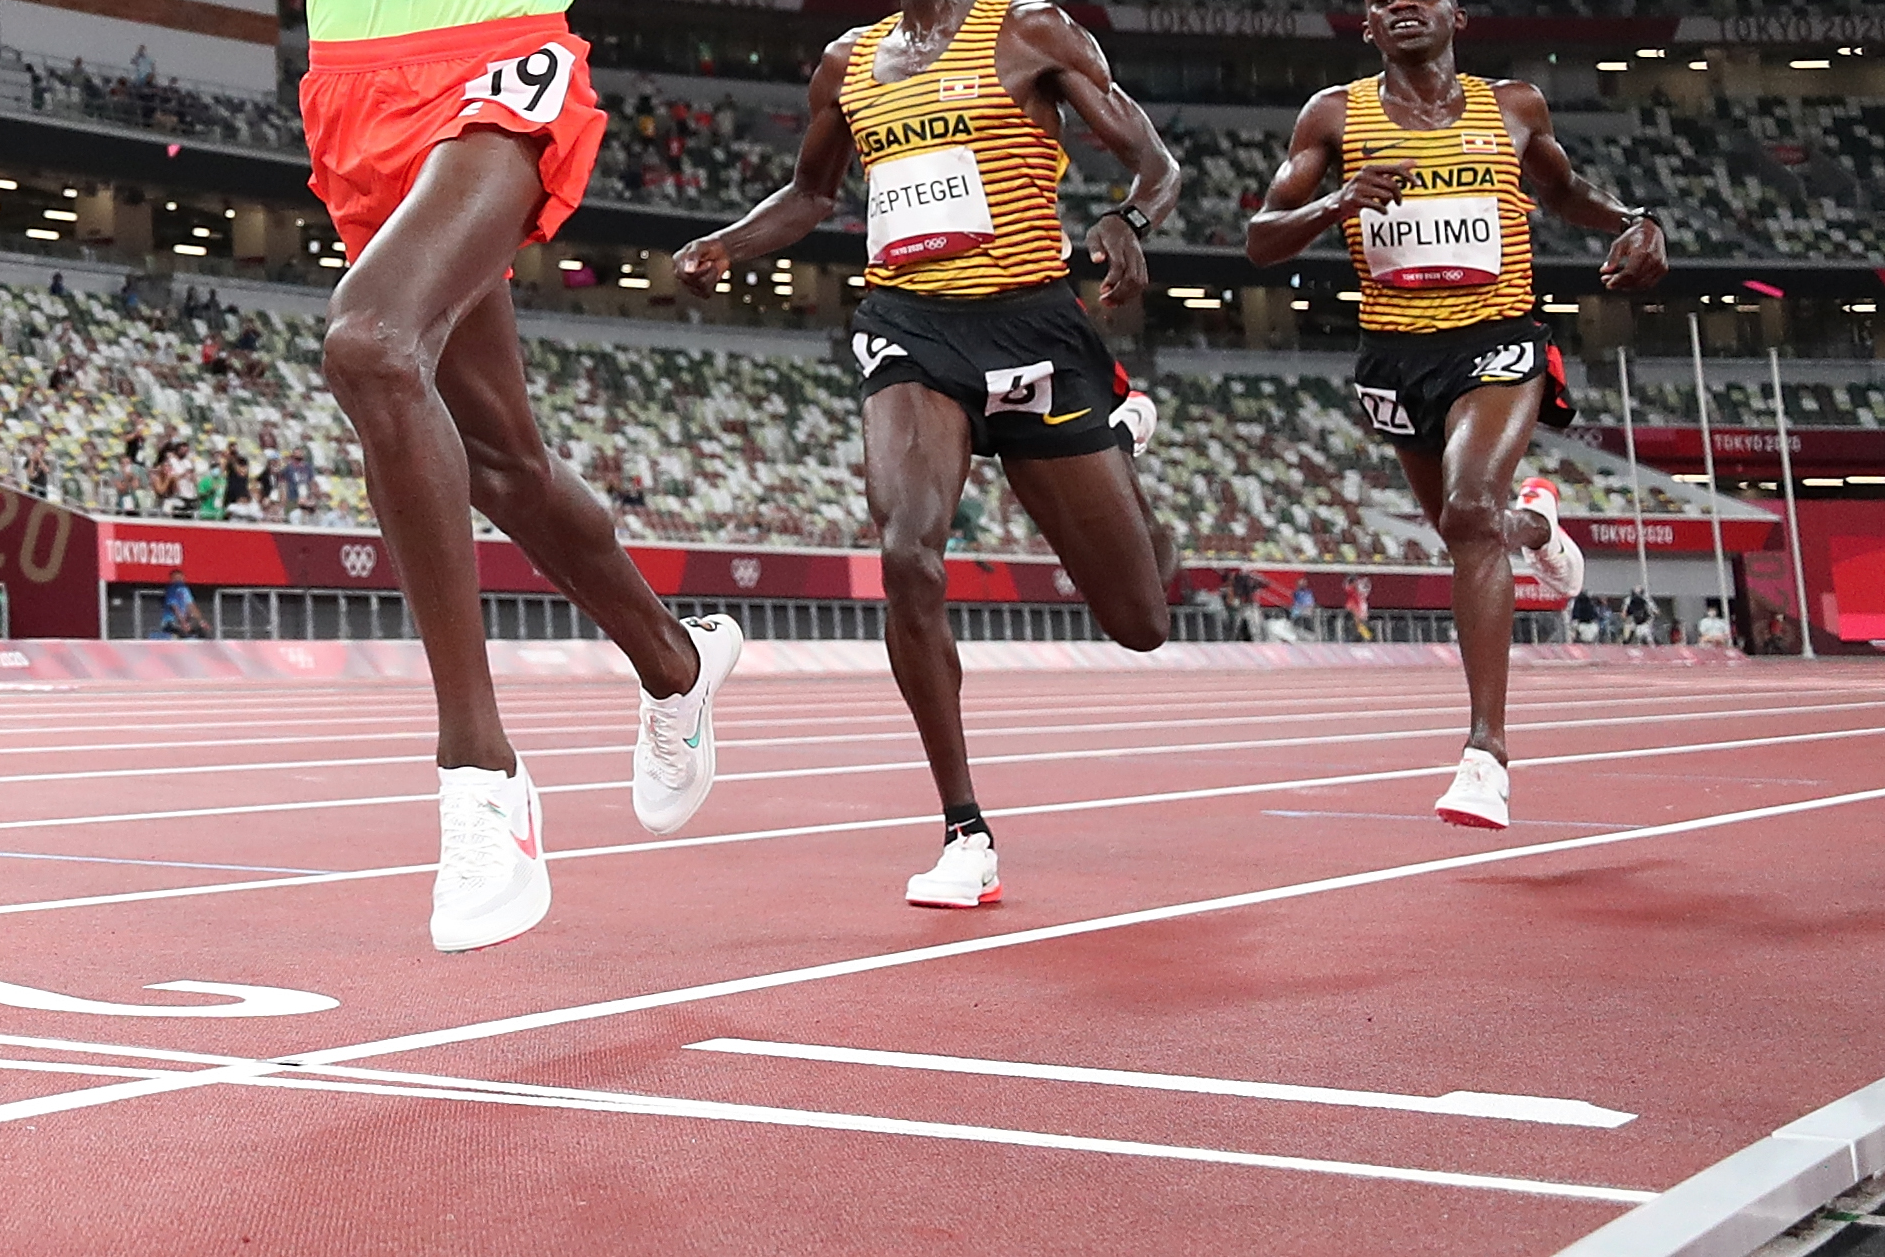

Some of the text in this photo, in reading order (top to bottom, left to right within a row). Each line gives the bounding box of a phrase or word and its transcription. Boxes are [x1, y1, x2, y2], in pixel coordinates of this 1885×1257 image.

[490, 48, 558, 112] 19
[857, 114, 973, 157] UGANDA
[1370, 218, 1490, 247] KIPLIMO
[1590, 524, 1636, 543] TOKYO
[105, 539, 183, 565] TOKYO 2020
